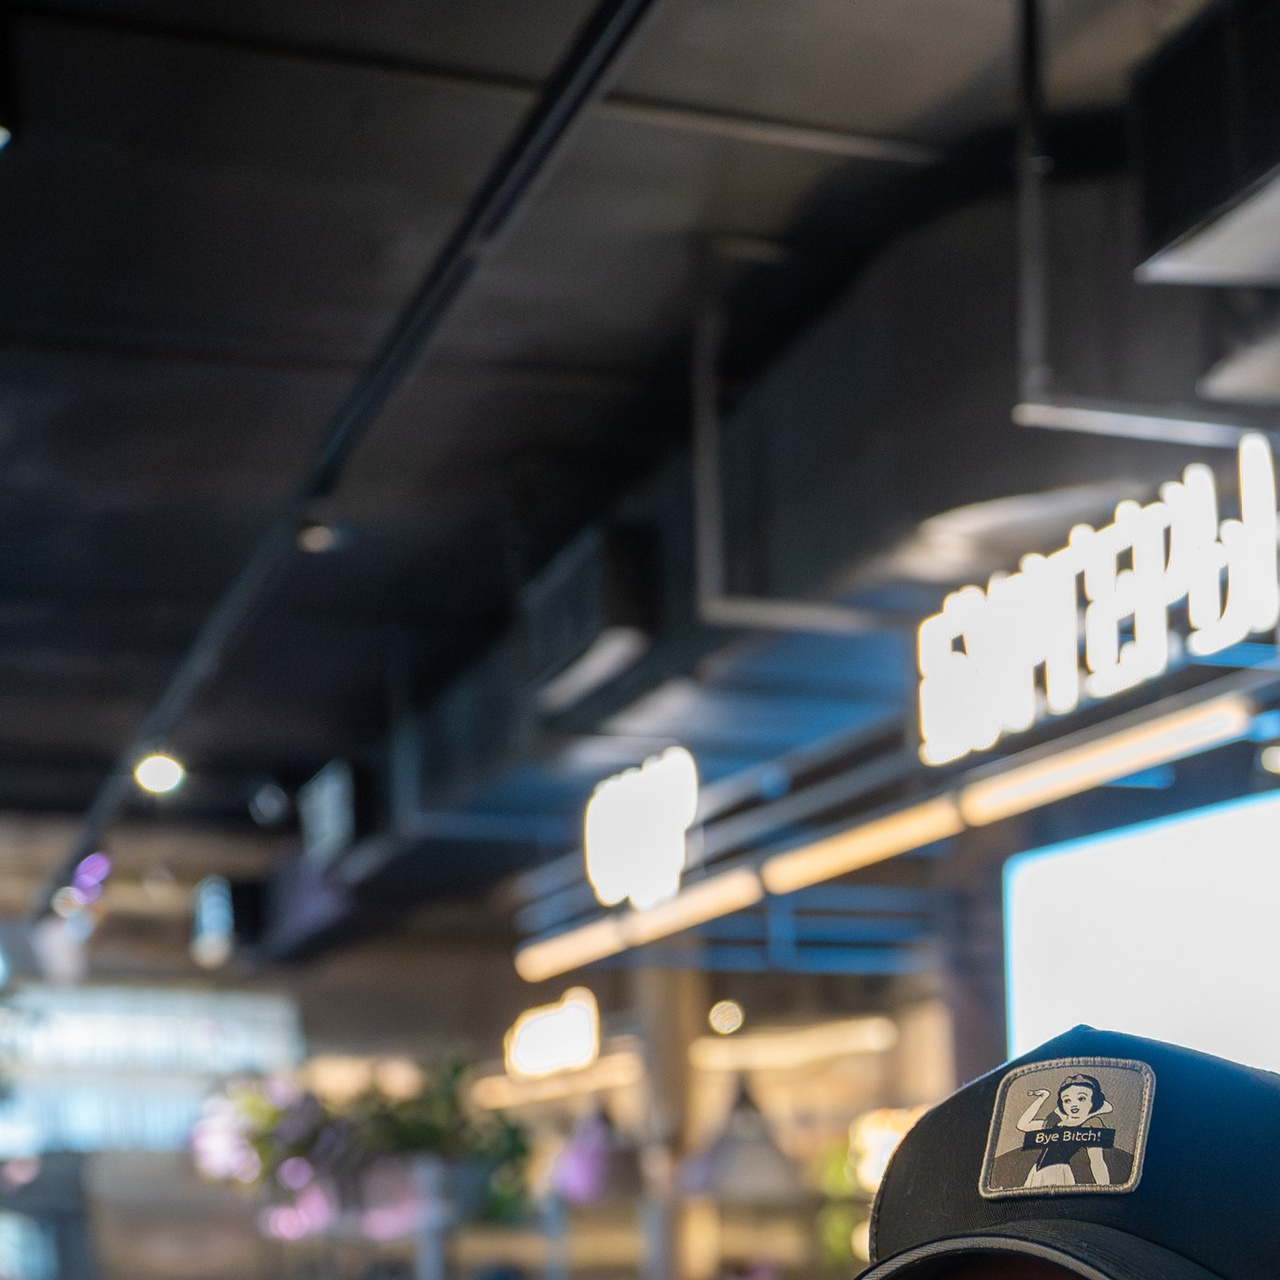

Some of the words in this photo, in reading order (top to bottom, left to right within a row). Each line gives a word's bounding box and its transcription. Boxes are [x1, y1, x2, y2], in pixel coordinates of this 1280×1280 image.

[918, 432, 1280, 767] ГЕРЫ
[1035, 1132, 1059, 1145] Bye
[1062, 1129, 1101, 1142] Bitch!
